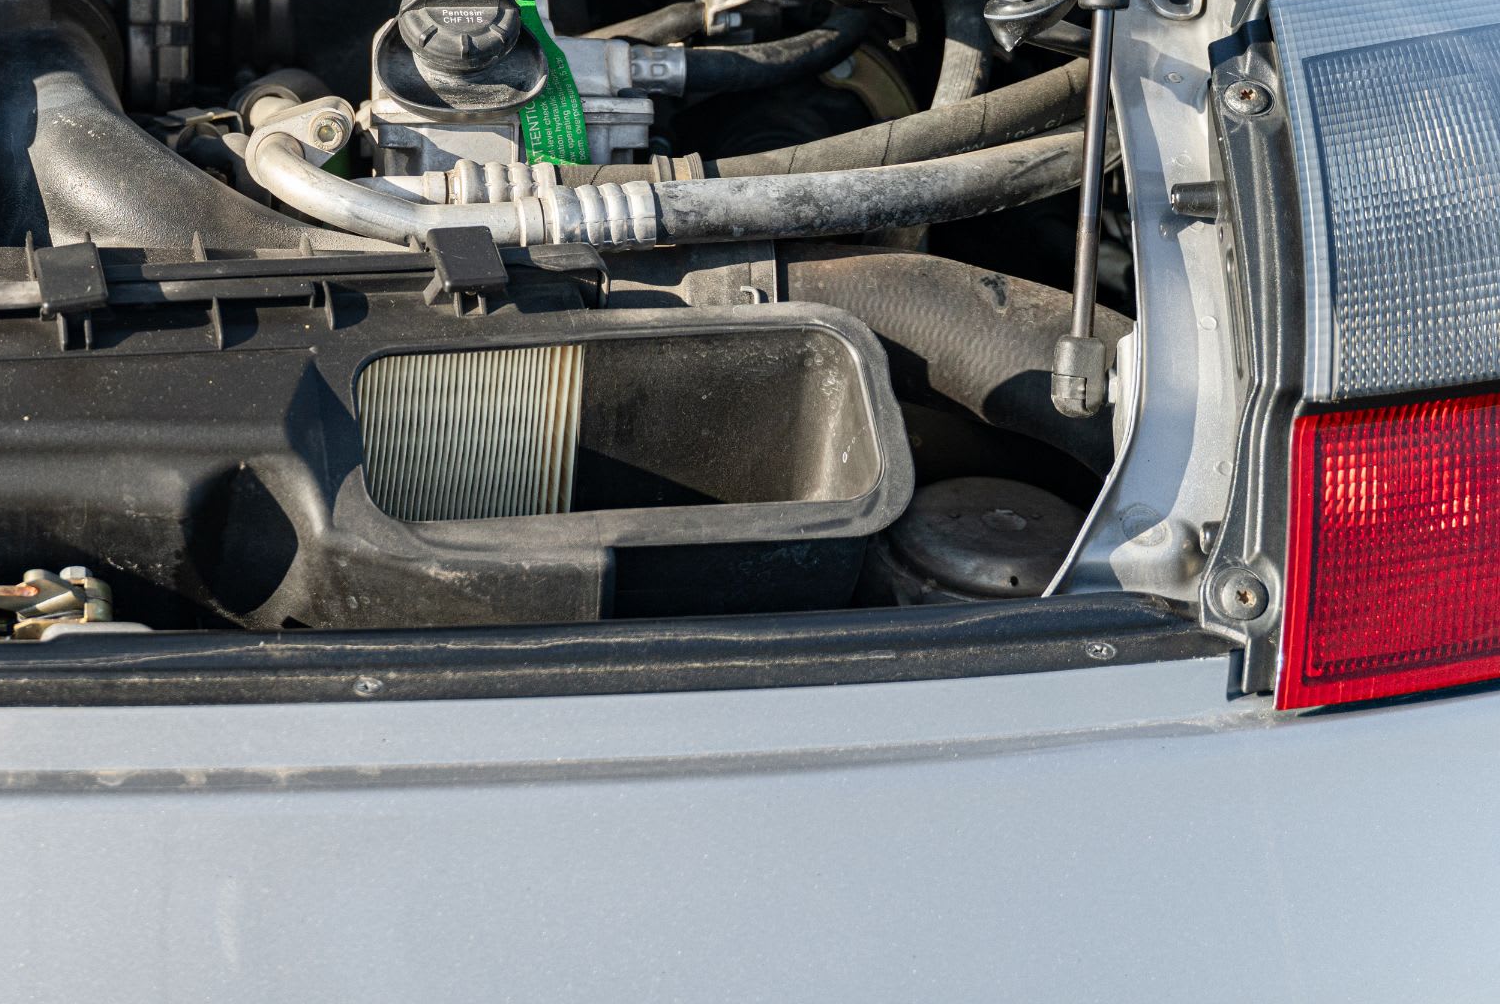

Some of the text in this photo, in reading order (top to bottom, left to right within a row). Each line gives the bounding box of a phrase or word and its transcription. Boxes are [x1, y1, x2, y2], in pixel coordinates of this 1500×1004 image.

[442, 9, 482, 17] Pentosin
[540, 101, 551, 126] check
[550, 95, 563, 133] hydraulic
[566, 83, 582, 135] overpressure
[545, 127, 554, 147] level
[563, 110, 574, 149] operating
